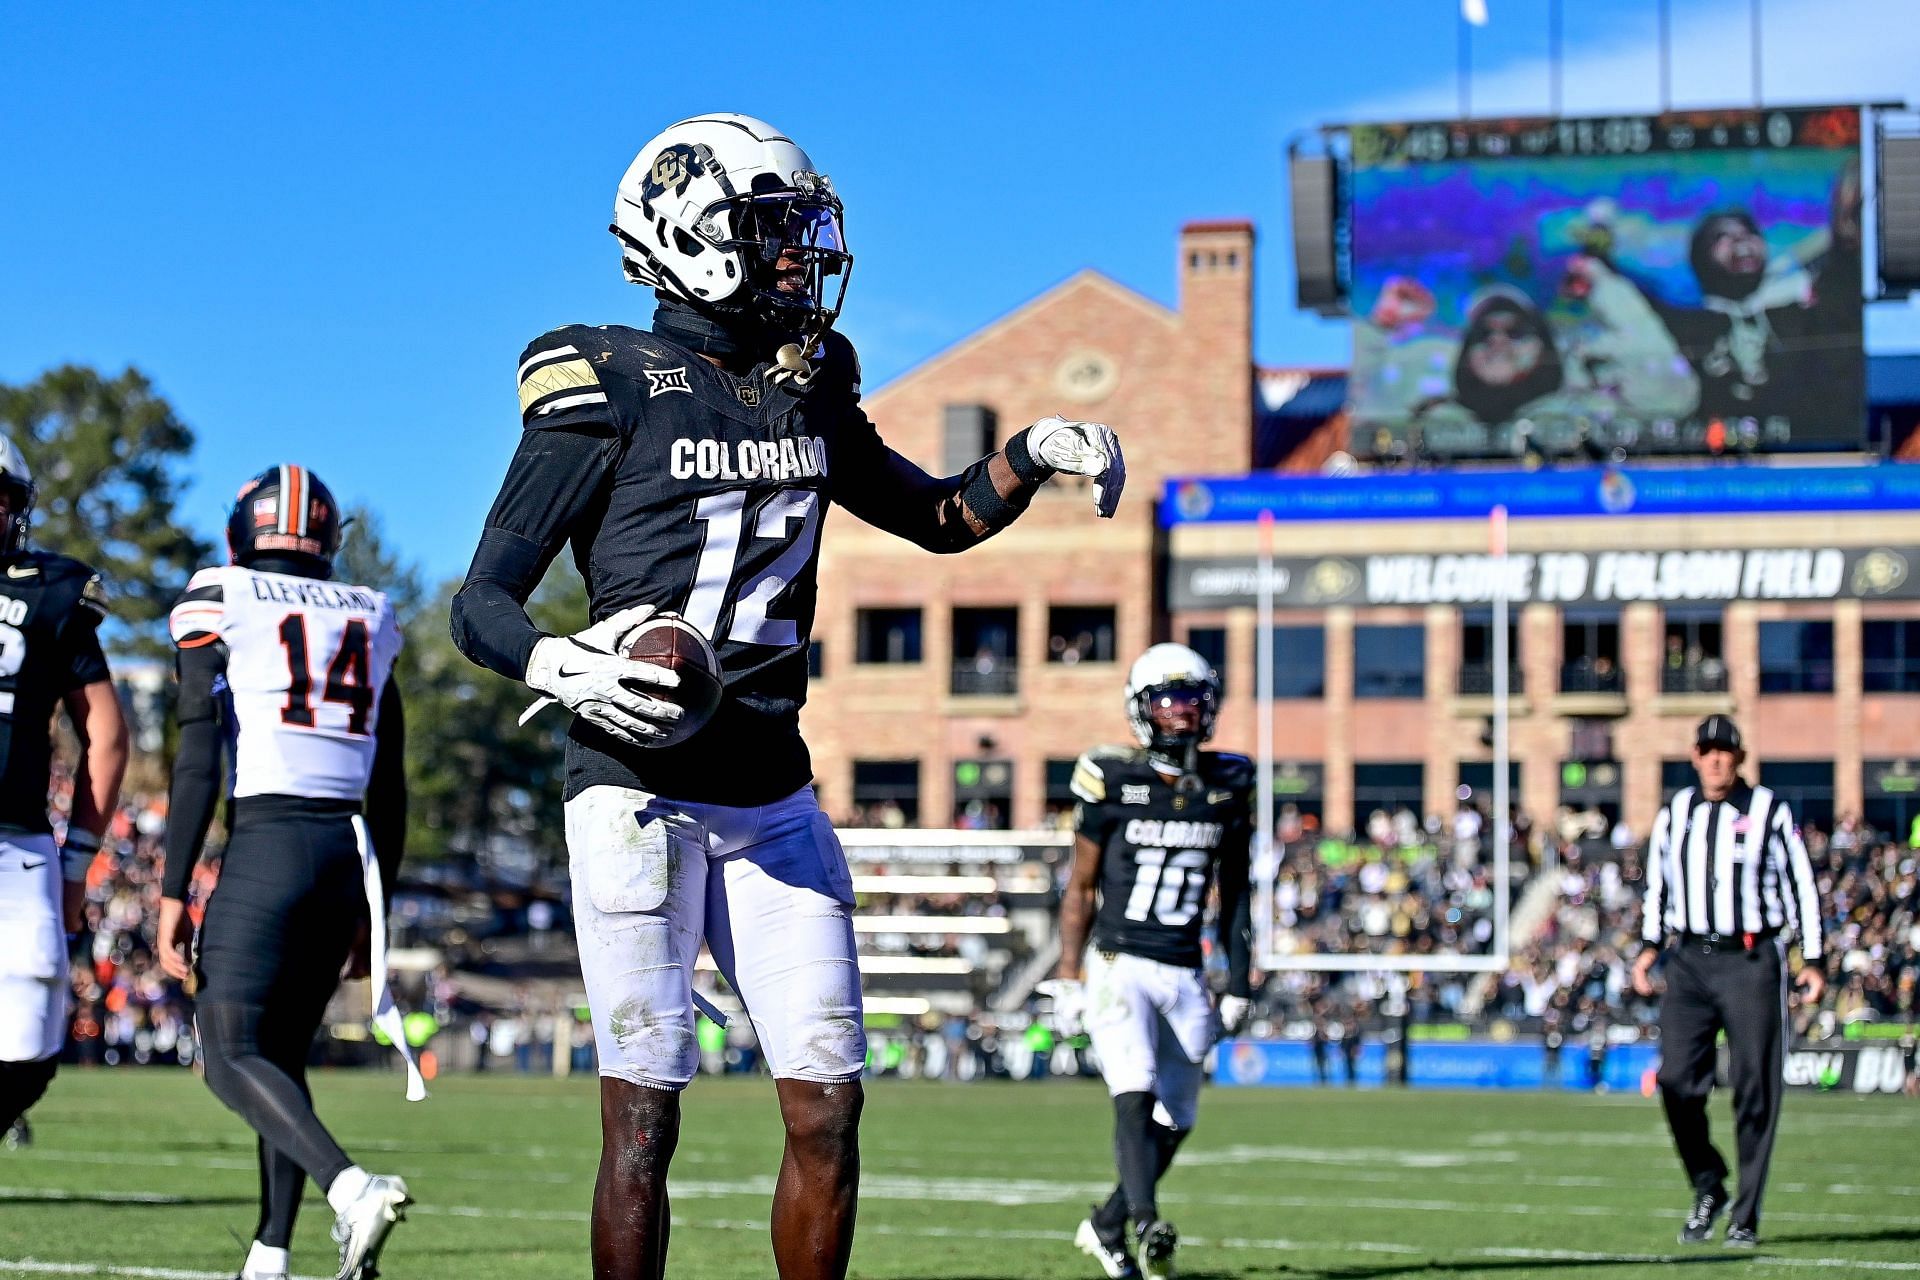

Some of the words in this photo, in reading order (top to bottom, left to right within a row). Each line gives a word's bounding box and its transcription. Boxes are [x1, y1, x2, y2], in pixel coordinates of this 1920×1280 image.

[648, 368, 690, 396] XII
[671, 437, 828, 480] COLORADO
[680, 488, 819, 646] 12
[1366, 554, 1535, 604] WELCOME
[1539, 552, 1590, 601] TO
[1594, 550, 1740, 601] FOLSOM
[1740, 548, 1845, 599] FIELD
[251, 576, 377, 612] CLEVELAND
[278, 613, 374, 737] 14
